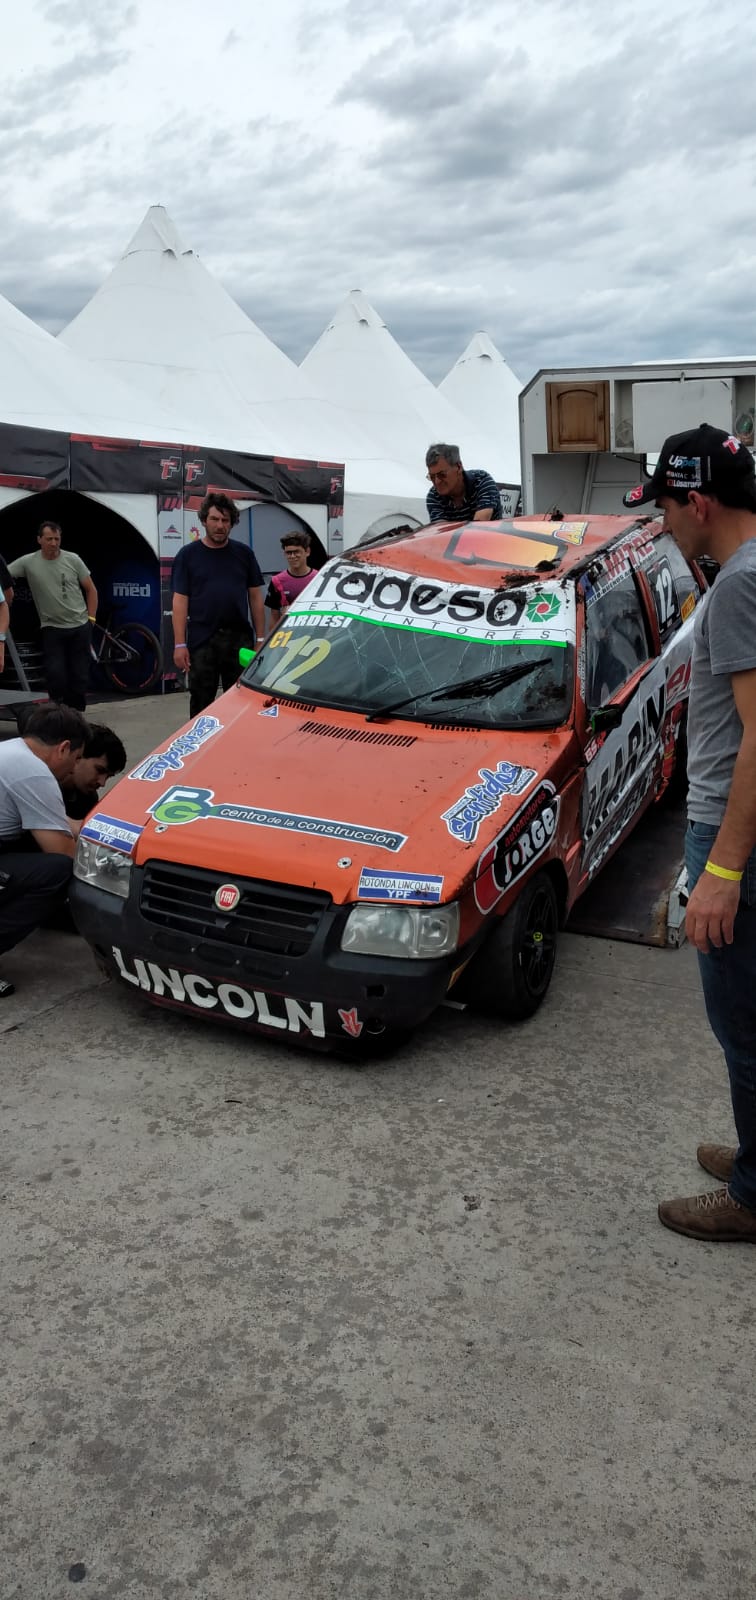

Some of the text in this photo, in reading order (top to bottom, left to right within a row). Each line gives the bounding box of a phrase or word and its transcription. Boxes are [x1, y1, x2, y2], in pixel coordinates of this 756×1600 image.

[314, 561, 527, 627] fadesa
[656, 567, 676, 627] 12
[269, 630, 291, 648] C1
[282, 615, 352, 629] ARDESI
[308, 601, 551, 640] EXTINTORES
[261, 635, 331, 694] 12
[450, 762, 519, 840] Sentidos
[504, 790, 547, 847] automotores
[98, 833, 115, 844] YPF
[220, 806, 398, 848] centro de la construcción
[220, 890, 236, 904] FIAT
[359, 875, 397, 889] ROTONDA
[397, 879, 431, 891] LINCOLN
[387, 890, 411, 899] YPF
[112, 945, 326, 1037] LINCOLN
